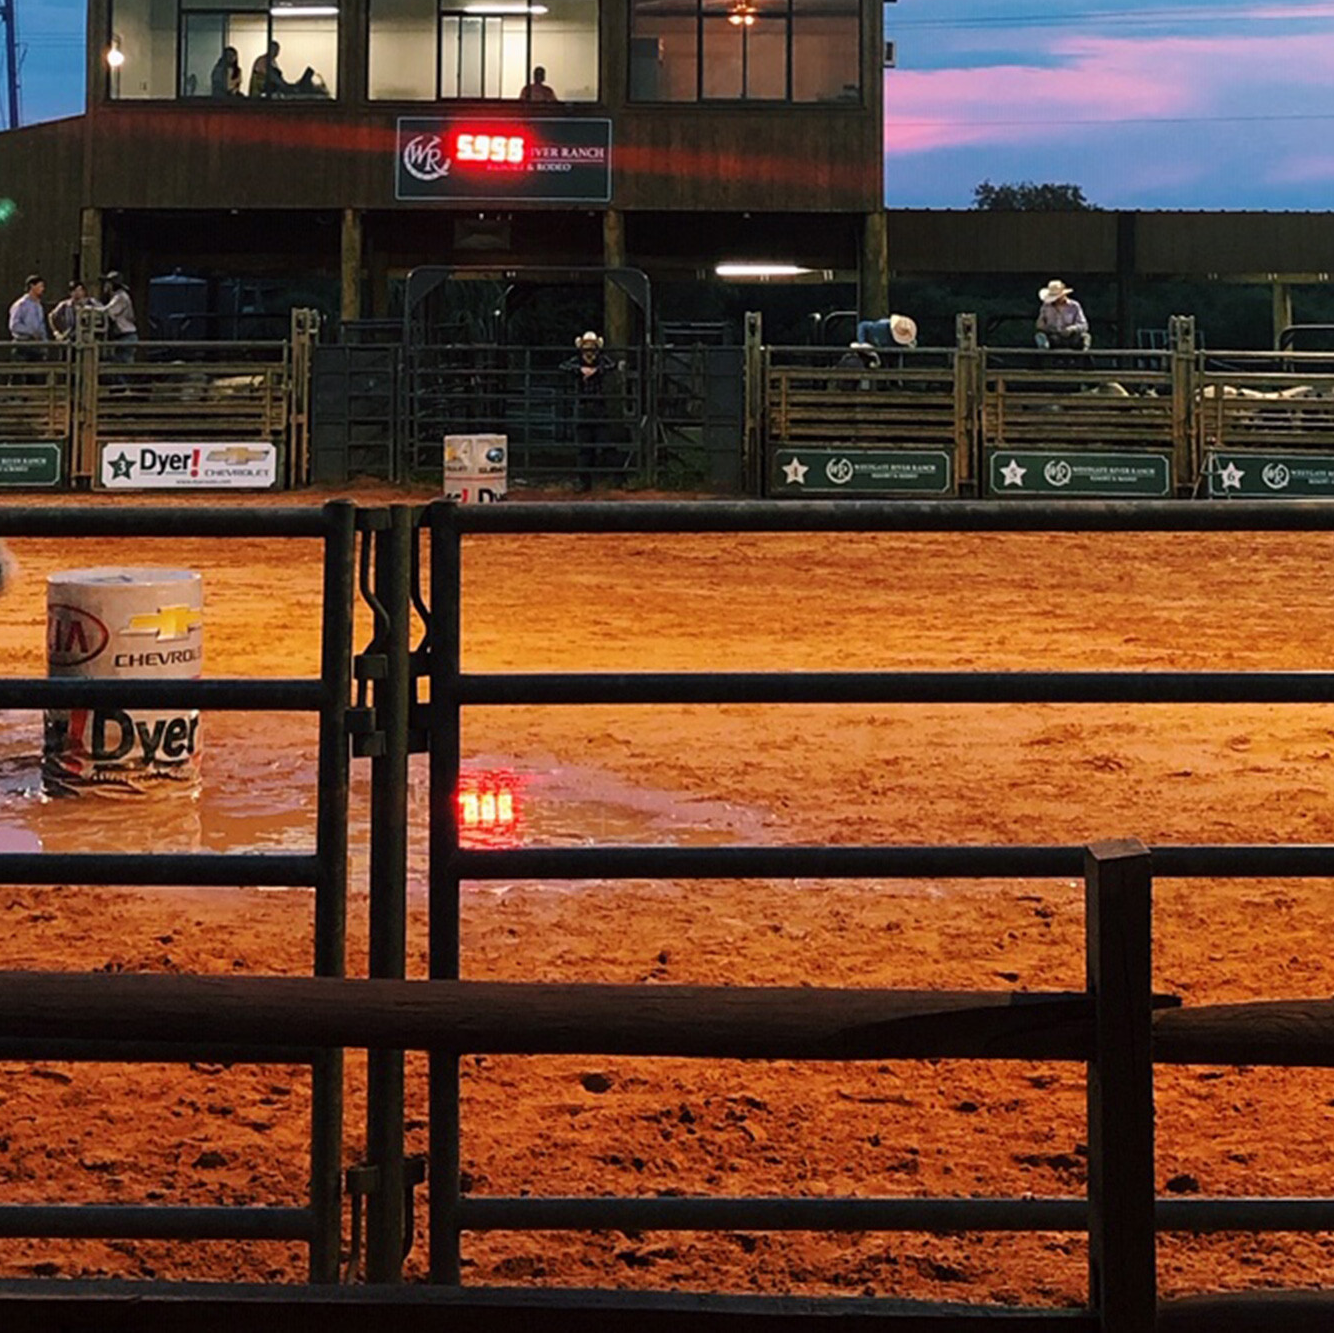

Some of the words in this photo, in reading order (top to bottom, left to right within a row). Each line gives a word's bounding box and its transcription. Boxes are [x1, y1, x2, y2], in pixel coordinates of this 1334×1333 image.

[530, 147, 559, 158] IVER
[561, 148, 604, 159] RANCH
[536, 163, 572, 172] RODEO
[117, 461, 126, 474] 3
[140, 448, 200, 478] Dyer!
[204, 468, 270, 478] CHEVROLET
[1226, 469, 1236, 482] 6
